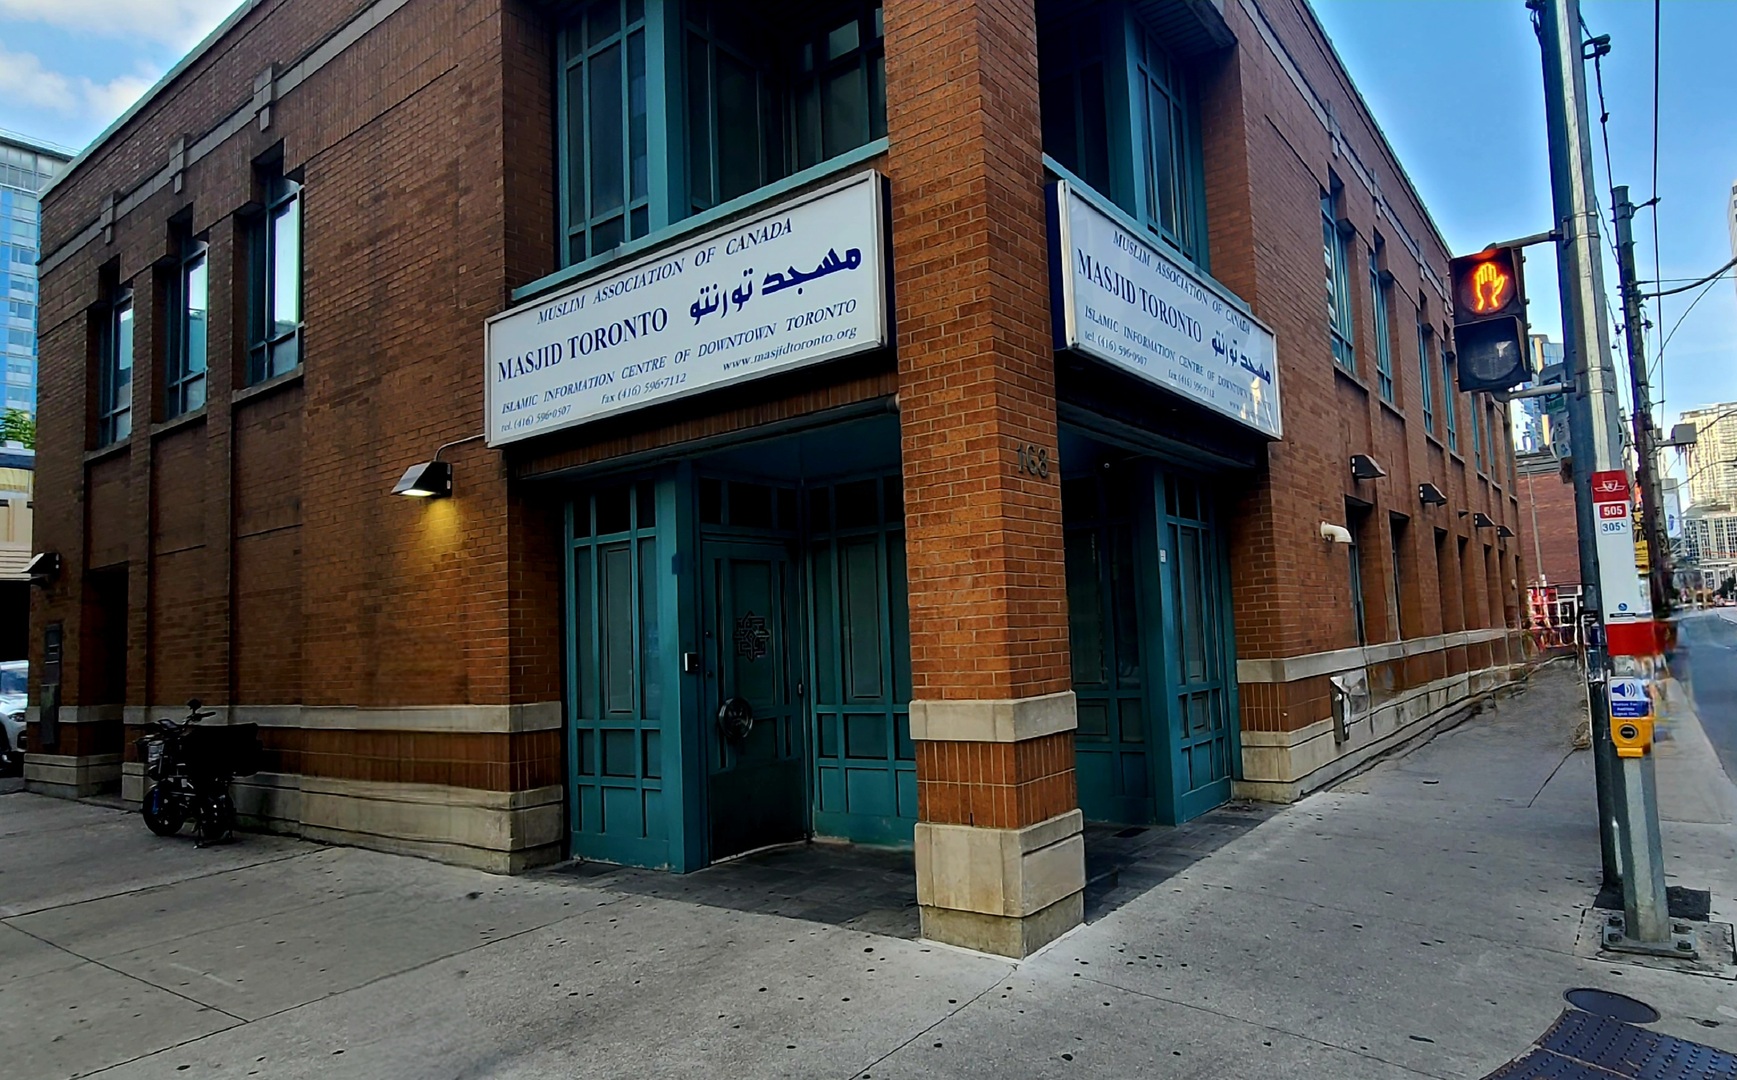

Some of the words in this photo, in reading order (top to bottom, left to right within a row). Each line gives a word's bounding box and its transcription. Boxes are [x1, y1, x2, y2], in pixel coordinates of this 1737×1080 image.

[537, 295, 586, 325] MUSLIM
[592, 257, 685, 303] ASSOCIATION
[694, 246, 716, 267] OF
[725, 218, 792, 256] CANADA
[762, 247, 862, 296] مسجد
[1077, 247, 1136, 305] MASJID
[1139, 286, 1202, 343] TORONTO
[1113, 230, 1151, 267] MUSLIM
[1155, 261, 1209, 306] ASSOCIATION
[1212, 300, 1222, 314] OF
[1225, 309, 1251, 335] CANADA
[689, 267, 753, 326] تورنتو
[498, 342, 562, 383] MASJID
[567, 307, 668, 360] TORONTO
[501, 394, 539, 414] ISLAMIC
[543, 371, 616, 403] INFORMATION
[621, 355, 667, 380] CENTRE
[674, 348, 691, 364] OF
[698, 323, 777, 358] DOWNTOWN
[786, 299, 857, 332] TORONTO
[722, 326, 858, 371] www.masjidtoronto.org
[1085, 305, 1119, 333] ISLAMIC
[1123, 325, 1176, 362] INFORMATION
[1207, 370, 1216, 382] OF
[1097, 334, 1117, 352] (416)
[601, 393, 615, 405] fax
[617, 384, 642, 401] (416)
[501, 419, 513, 433] tel.
[513, 413, 534, 430] (416)
[1017, 443, 1049, 478] 168
[1602, 521, 1621, 532] 305
[1603, 505, 1623, 516] 505
